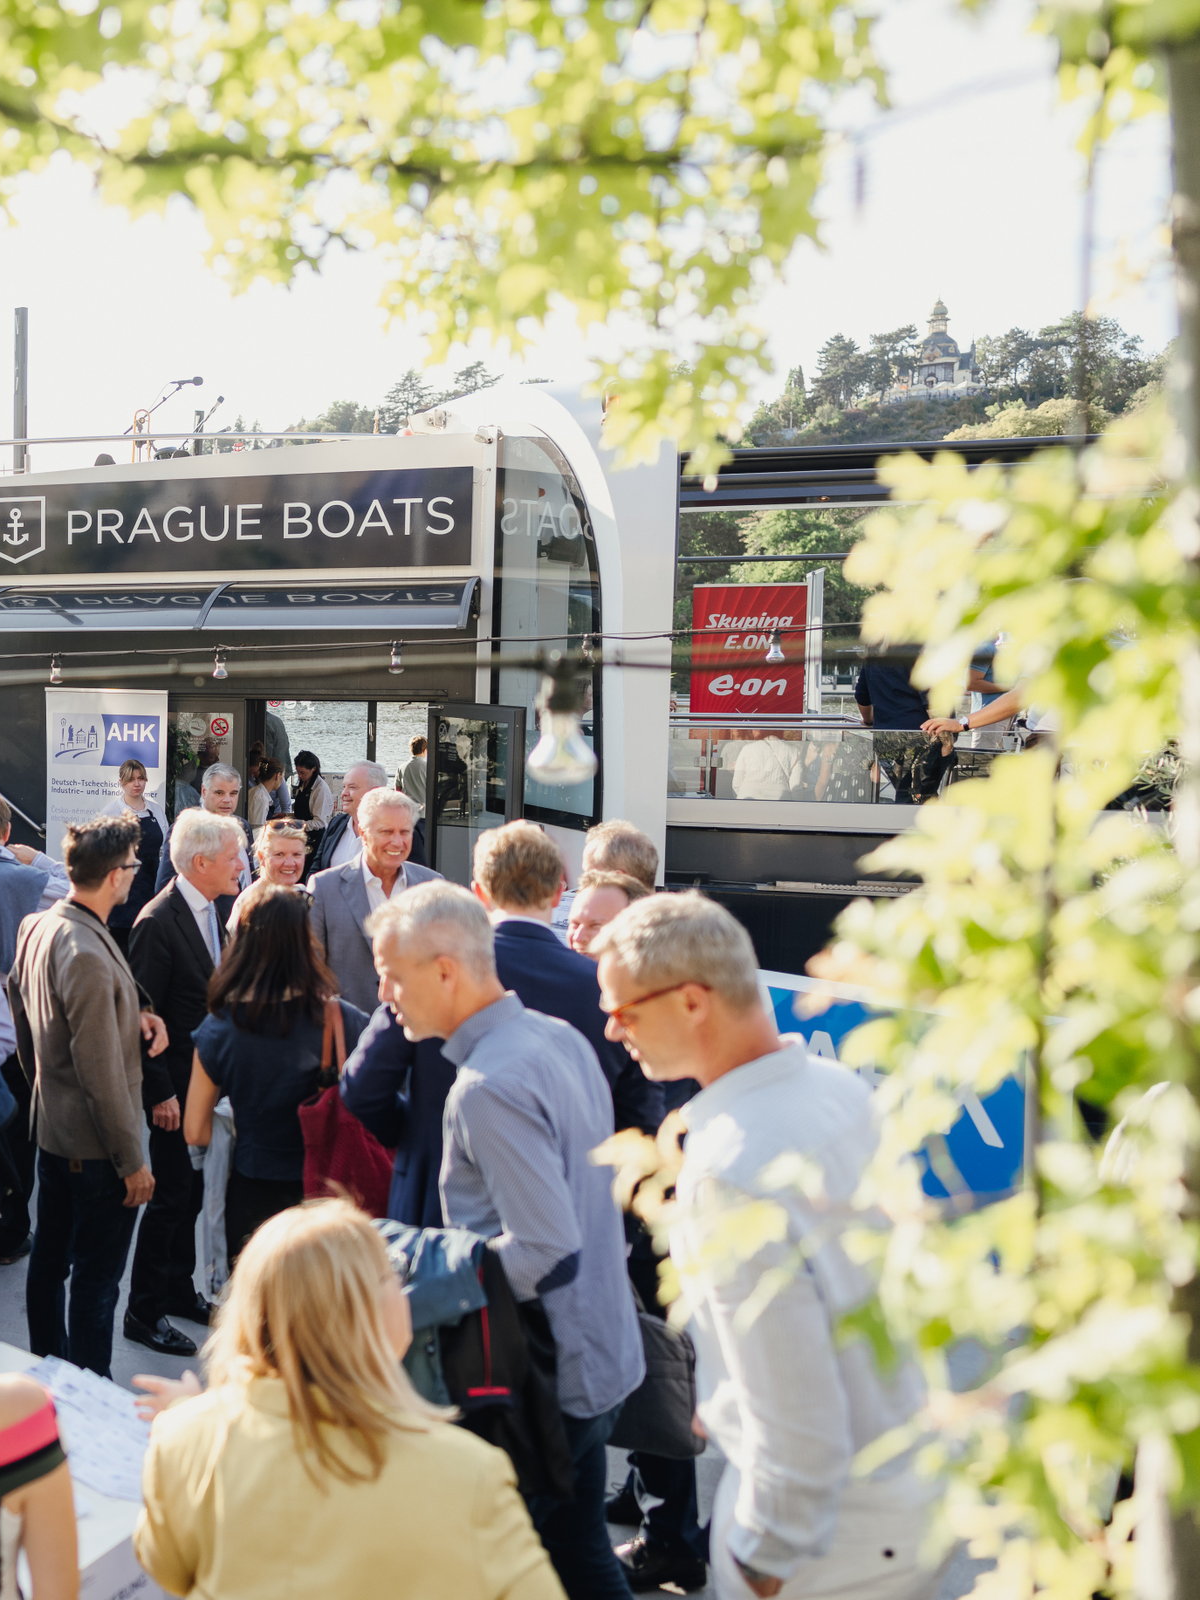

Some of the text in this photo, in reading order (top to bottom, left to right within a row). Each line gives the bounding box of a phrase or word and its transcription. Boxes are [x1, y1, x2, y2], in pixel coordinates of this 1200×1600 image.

[66, 496, 455, 546] PRAGUE BOATS
[705, 612, 794, 631] Skupina
[106, 722, 156, 743] AHK
[51, 786, 84, 795] Industrie-
